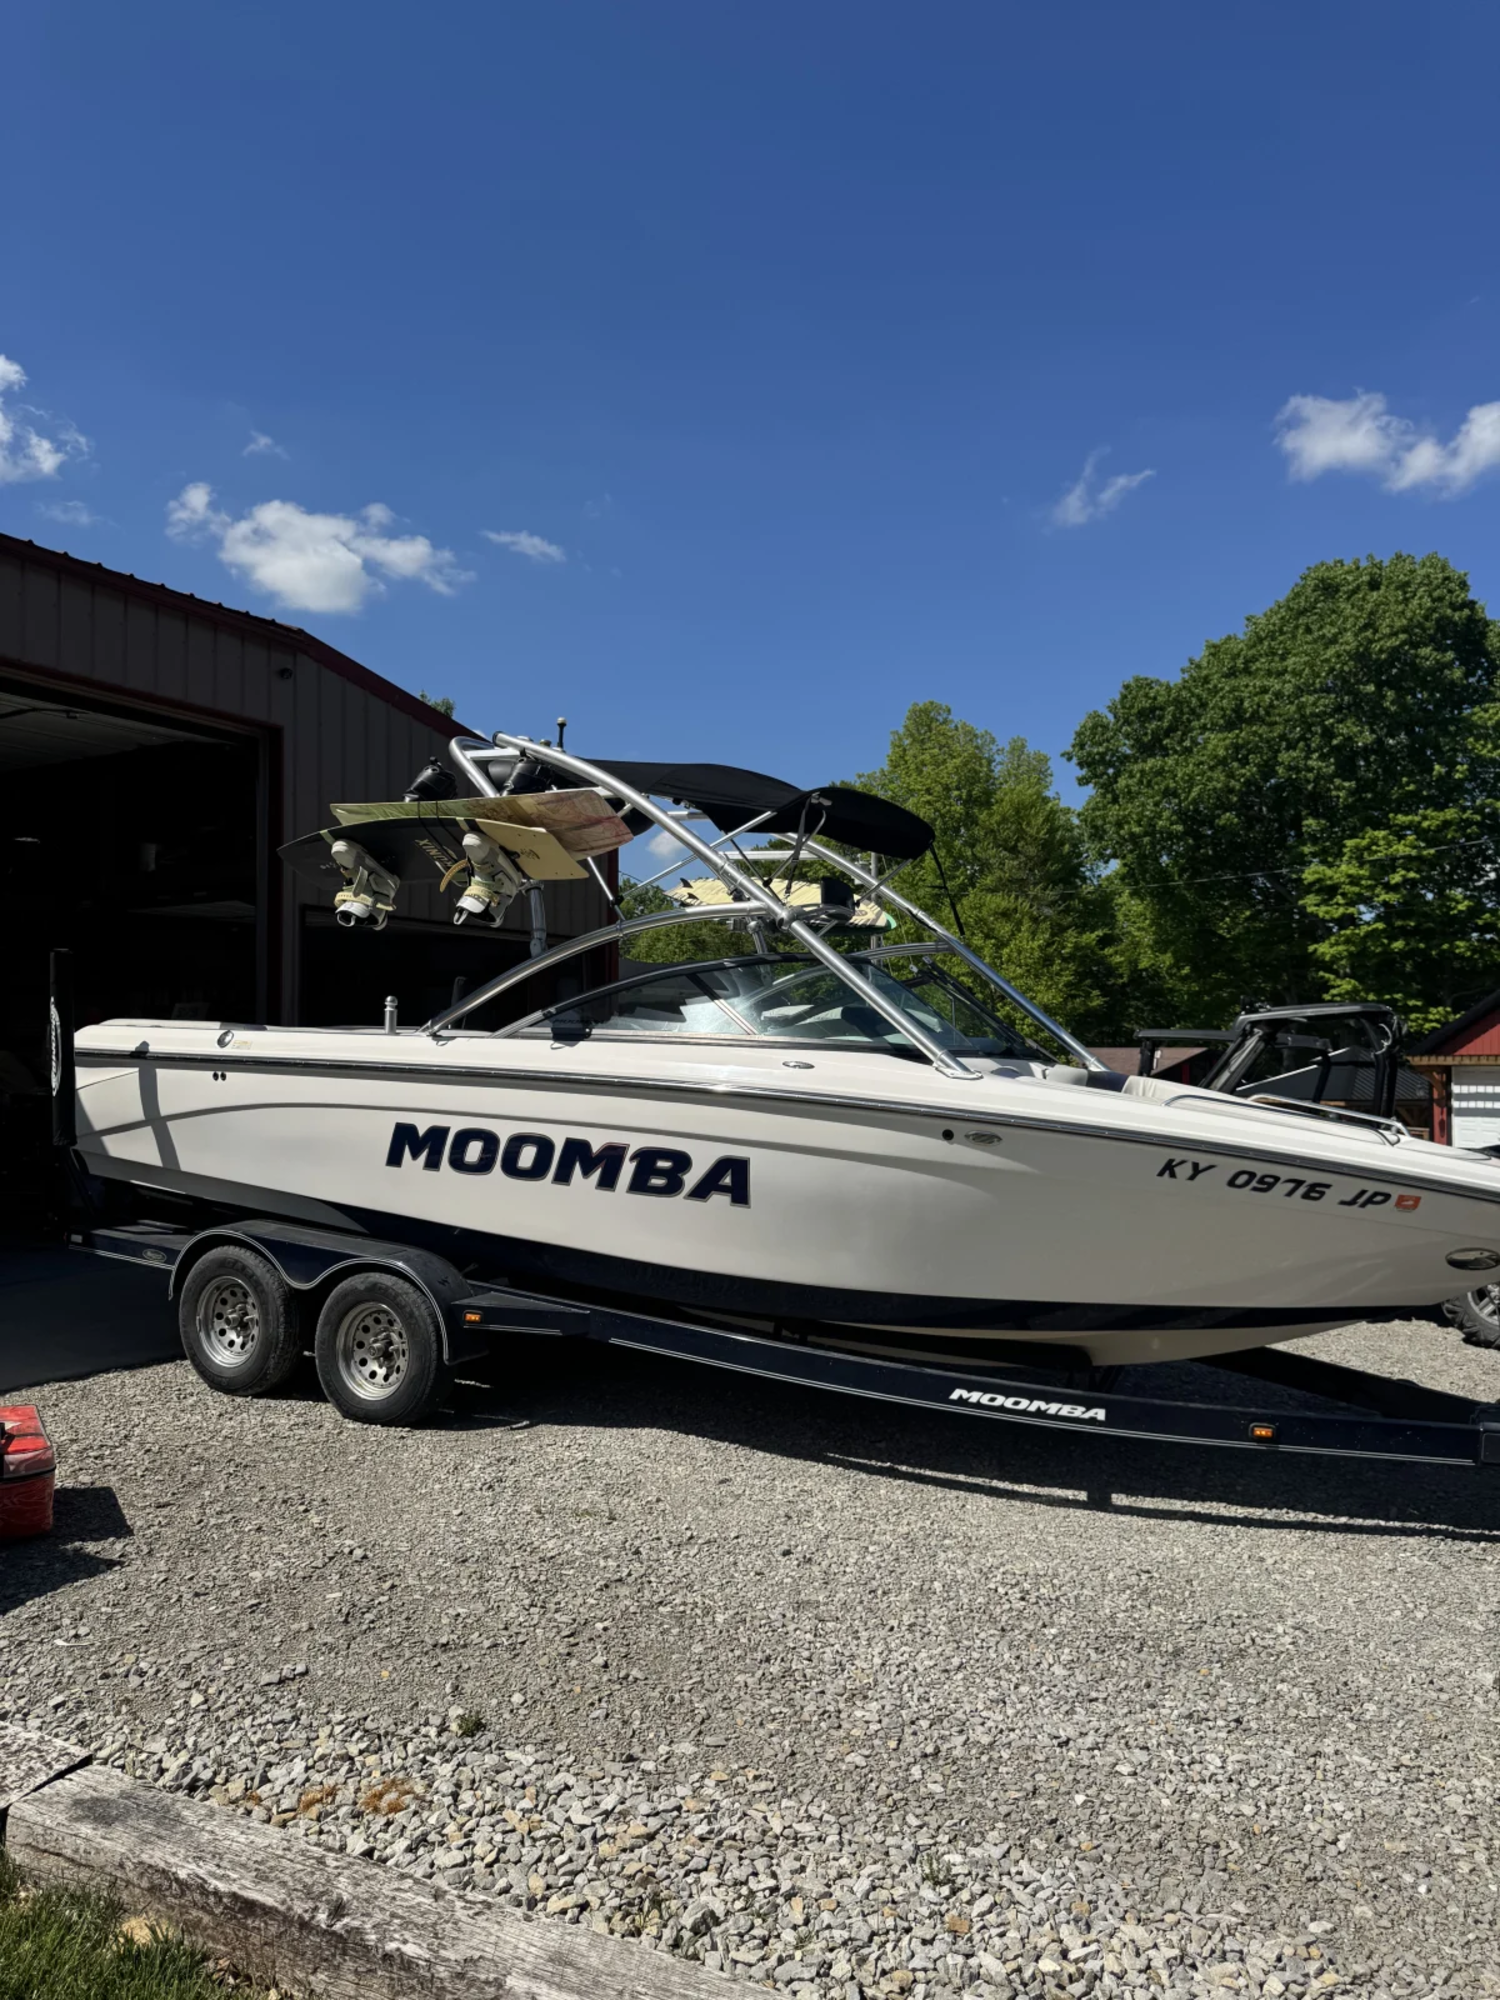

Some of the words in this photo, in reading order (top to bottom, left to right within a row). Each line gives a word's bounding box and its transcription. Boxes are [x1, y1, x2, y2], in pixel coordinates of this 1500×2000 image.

[385, 1121, 751, 1208] MOOMBA
[1156, 1158, 1217, 1181] KY
[1226, 1169, 1333, 1201] 0976
[1338, 1189, 1392, 1208] JP
[948, 1388, 1106, 1421] MOOMBA
